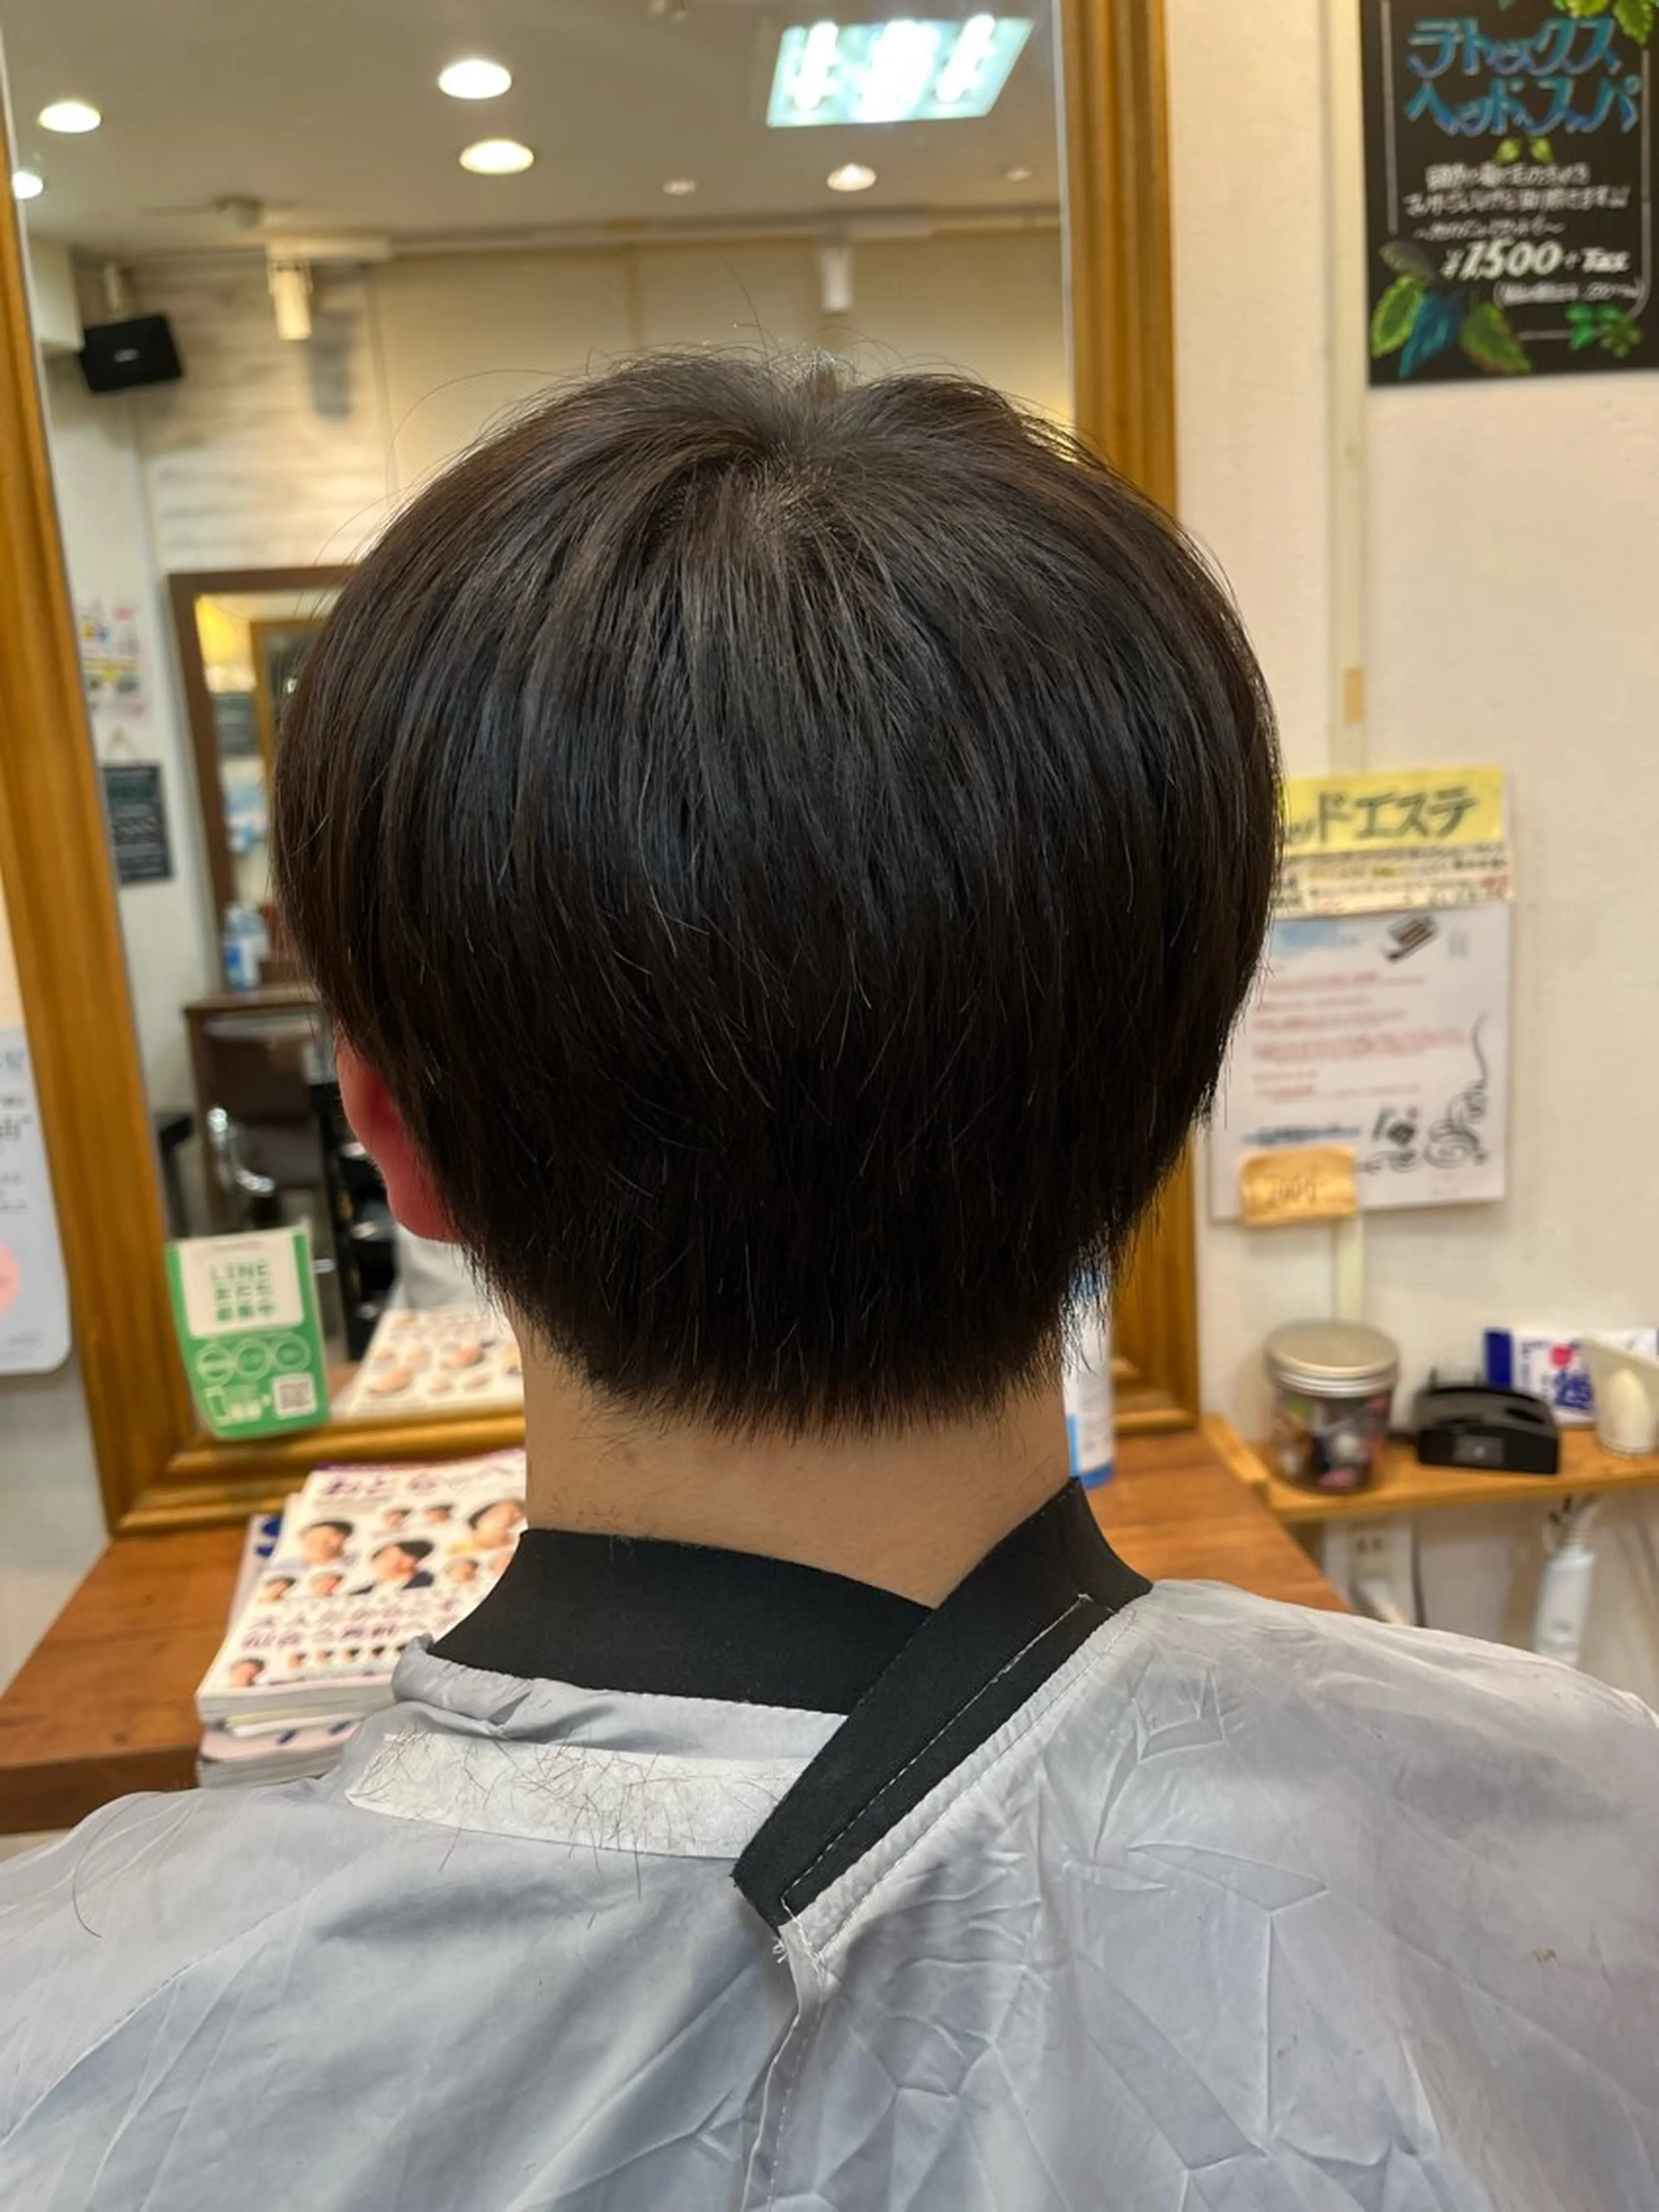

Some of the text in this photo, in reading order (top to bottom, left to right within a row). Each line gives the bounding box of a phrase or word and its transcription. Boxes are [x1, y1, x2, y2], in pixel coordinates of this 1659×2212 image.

[1405, 75, 1640, 135] ヘッドスパ
[1282, 787, 1477, 845] ッドエステ
